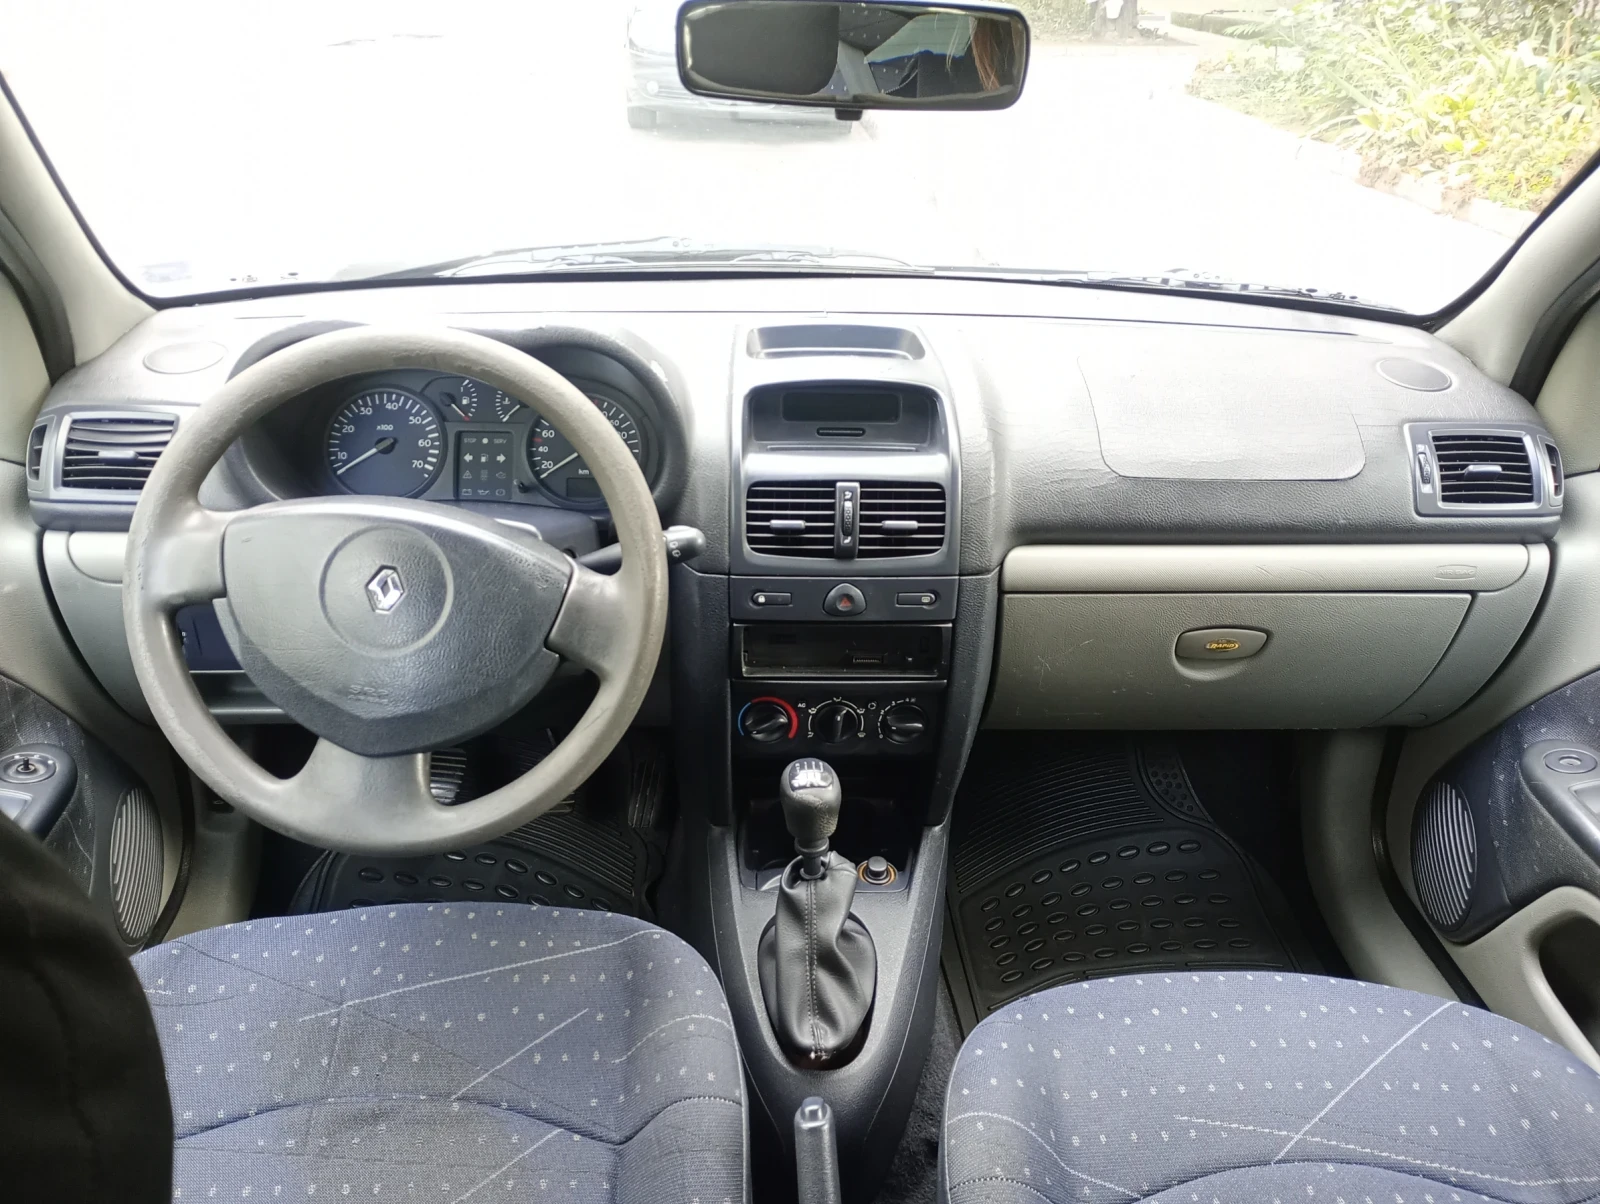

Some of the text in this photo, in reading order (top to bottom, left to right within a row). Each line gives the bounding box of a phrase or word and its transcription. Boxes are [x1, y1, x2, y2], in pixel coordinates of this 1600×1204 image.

[385, 402, 399, 410] 40
[359, 407, 373, 415] 30
[408, 416, 422, 424] 50
[342, 425, 355, 433] 20
[542, 430, 555, 438] 60
[418, 439, 431, 447] 60
[337, 451, 347, 460] 10
[412, 460, 424, 468] 70
[541, 461, 554, 469] 20
